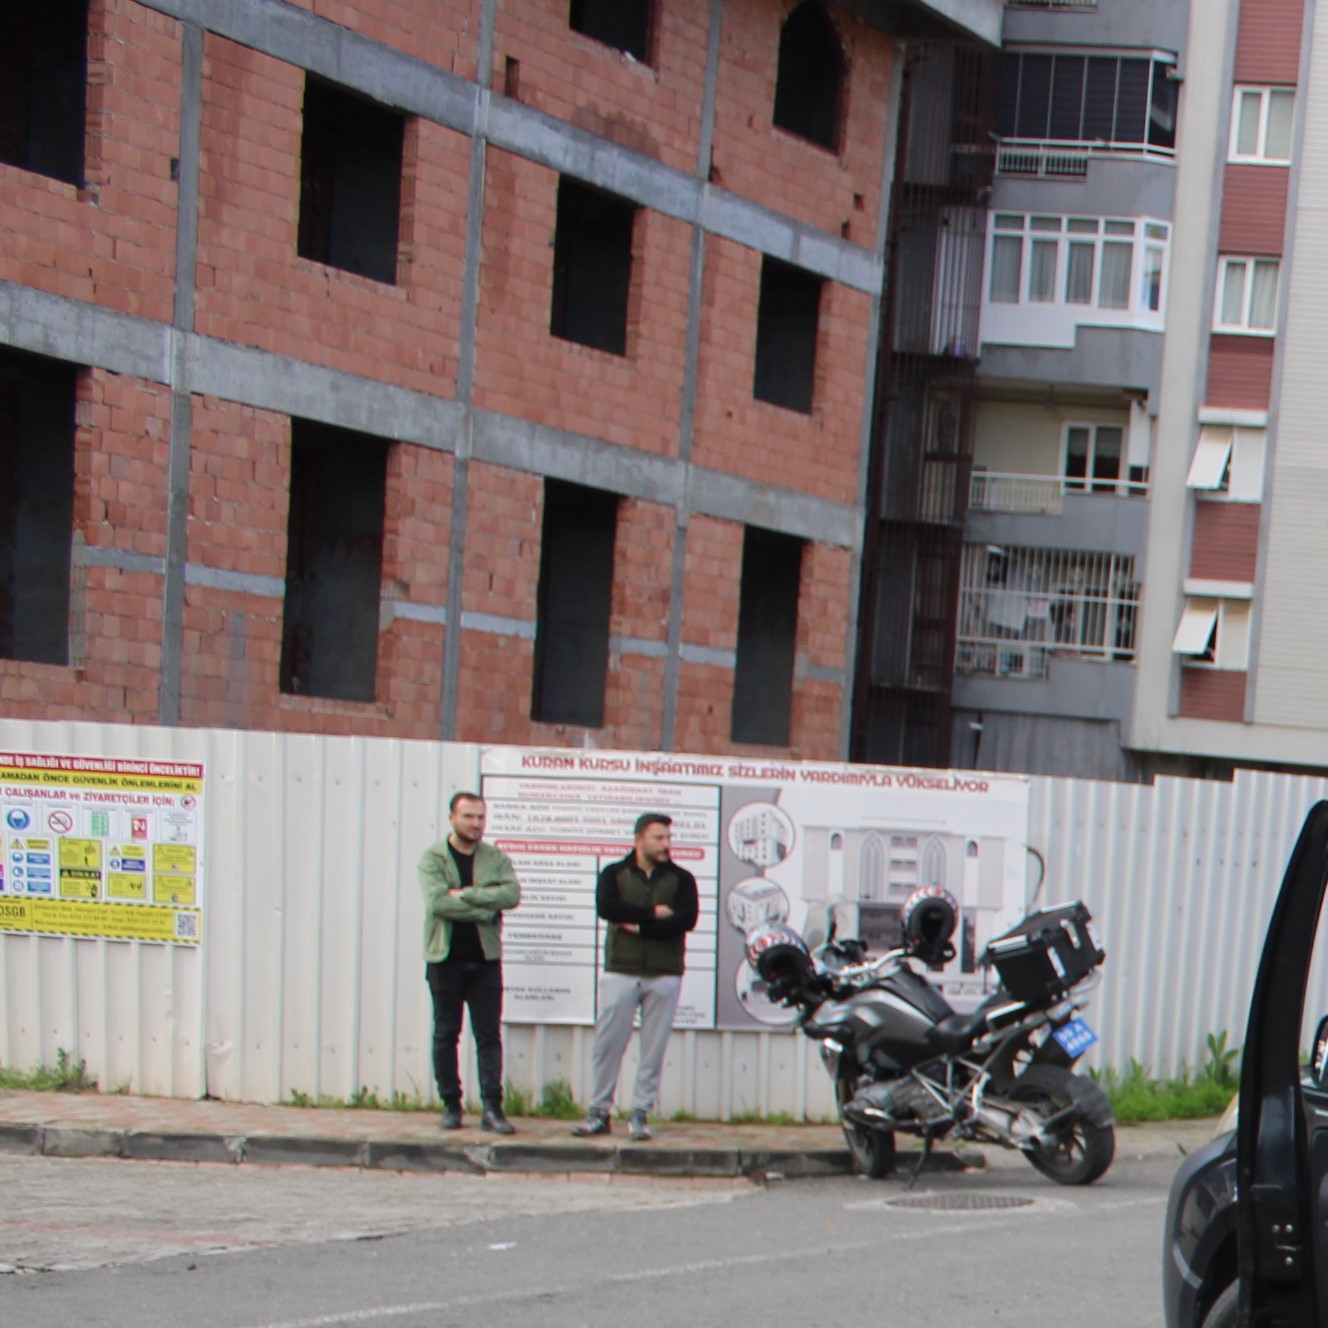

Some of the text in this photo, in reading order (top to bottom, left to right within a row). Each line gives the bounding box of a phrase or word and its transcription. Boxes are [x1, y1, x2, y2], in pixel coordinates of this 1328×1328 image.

[25, 756, 59, 768] SAĞLIĞI
[60, 759, 72, 769] VE
[73, 758, 116, 772] GÜVENLİĞİ
[117, 761, 148, 773] BİRİNCİ
[43, 772, 69, 782] ÖNCE
[73, 774, 118, 786] GÜVENLİK
[121, 778, 183, 789] ÖNLEMLERİNİ
[521, 754, 990, 794] KURAN KURSU İNŞAATIMIZ SİZLERİN YARDIMIYLA YÜKSELİYOR
[5, 786, 67, 800] ÇALIŞANLAR
[83, 790, 150, 805] ZİYARETÇİLER
